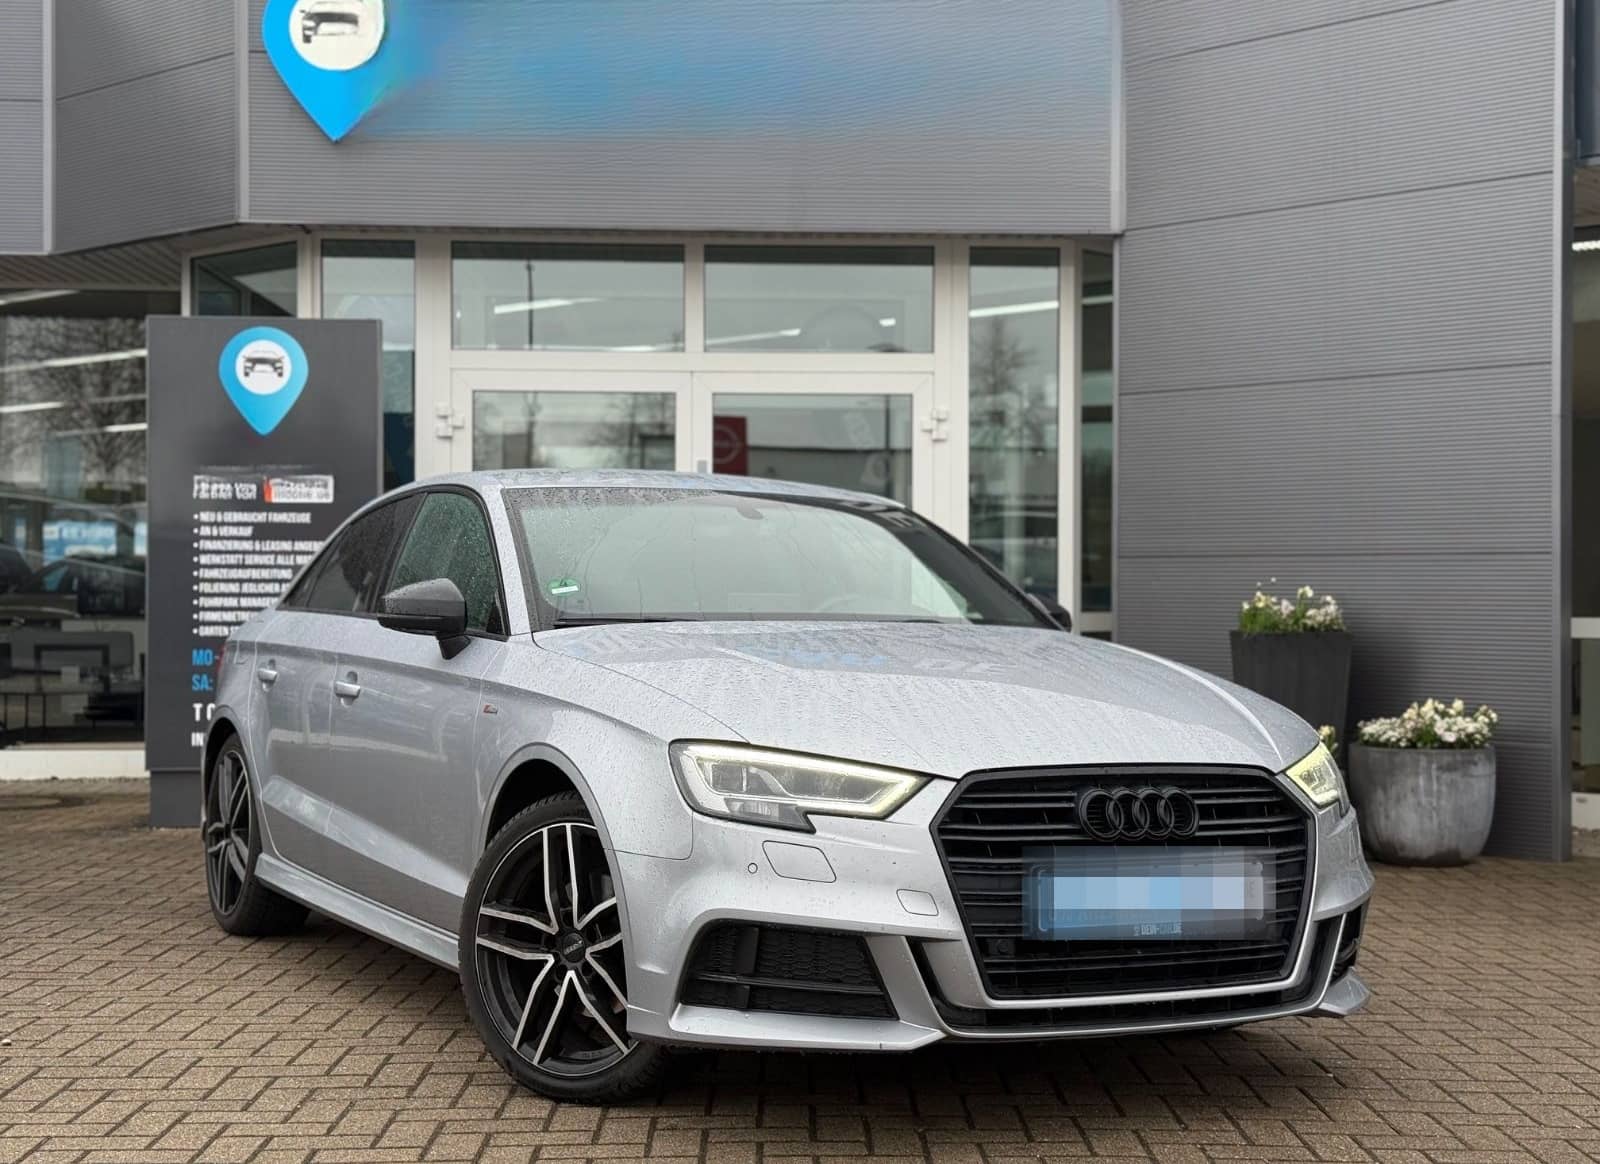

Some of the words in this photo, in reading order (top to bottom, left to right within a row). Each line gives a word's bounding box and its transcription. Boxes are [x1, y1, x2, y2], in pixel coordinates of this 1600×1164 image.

[199, 512, 216, 523] NEU
[223, 512, 267, 523] GEBRAUCHT
[268, 512, 312, 524] FAHRZEUGE
[199, 526, 211, 537] AN
[219, 526, 254, 537] VERKAUF
[199, 540, 254, 551] FINANZIERUNG
[261, 540, 293, 551] LEASING
[199, 554, 243, 565] WERKSTATT
[244, 554, 276, 565] SERVICE
[276, 554, 294, 565] ALLE
[199, 568, 293, 579] FAHRZEUGAUFBEREITUNG
[199, 582, 240, 593] FOLIERUNG
[241, 582, 281, 593] JEGLICHER
[199, 596, 239, 608] FUHRPARK
